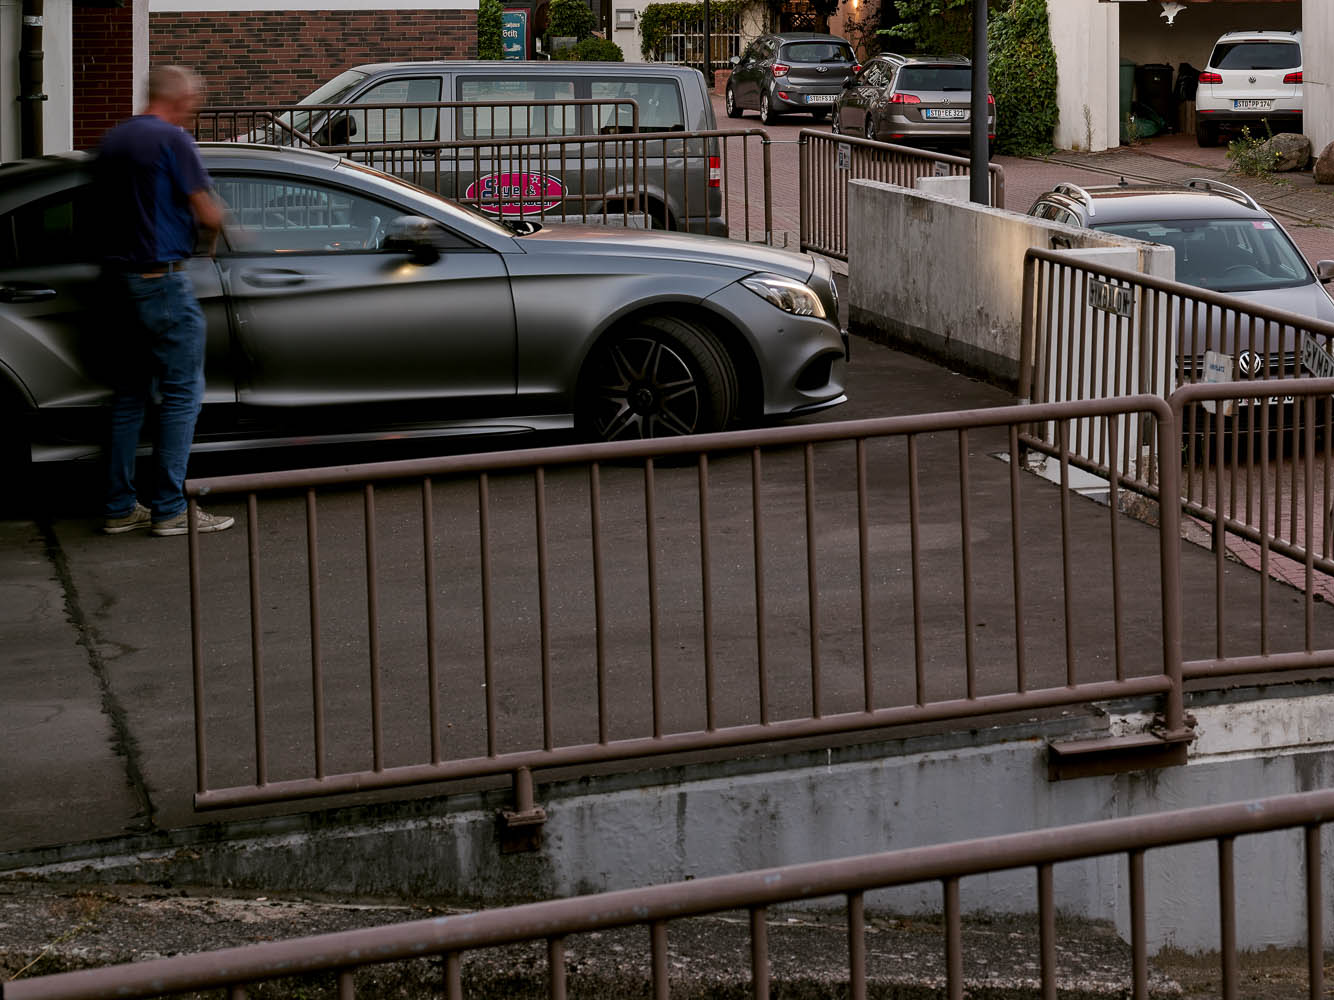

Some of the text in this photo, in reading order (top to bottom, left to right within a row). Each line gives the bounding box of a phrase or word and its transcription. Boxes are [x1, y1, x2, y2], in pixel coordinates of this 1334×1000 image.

[1238, 100, 1248, 108] STD
[1252, 100, 1260, 108] PP
[931, 109, 941, 117] STD
[945, 109, 953, 117] EE
[482, 179, 521, 198] Stye
